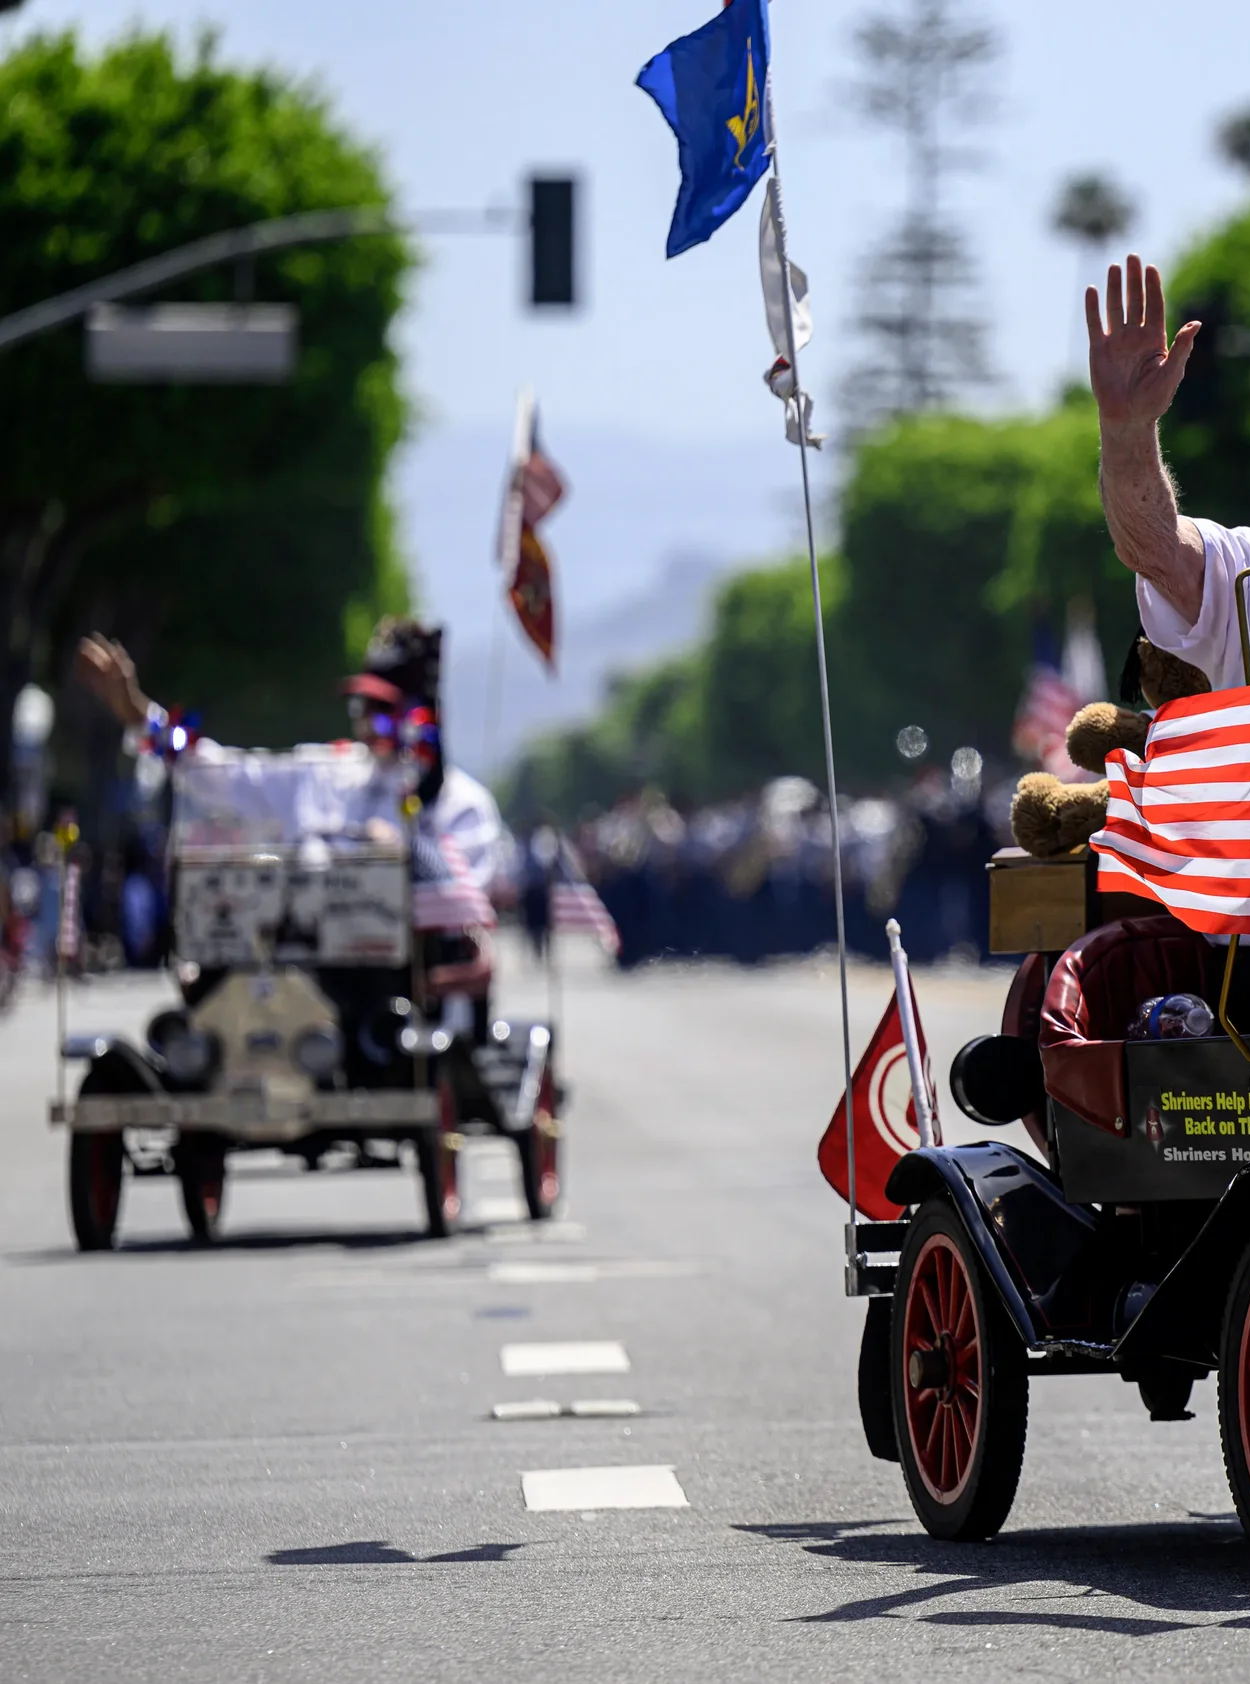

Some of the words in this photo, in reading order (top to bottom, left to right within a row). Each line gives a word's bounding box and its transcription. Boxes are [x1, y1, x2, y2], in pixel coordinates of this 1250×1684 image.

[1161, 1091, 1213, 1111] Shriners
[1216, 1092, 1245, 1114] Help
[1185, 1116, 1216, 1135] Back
[1219, 1122, 1235, 1135] on
[1163, 1147, 1226, 1161] Shriners
